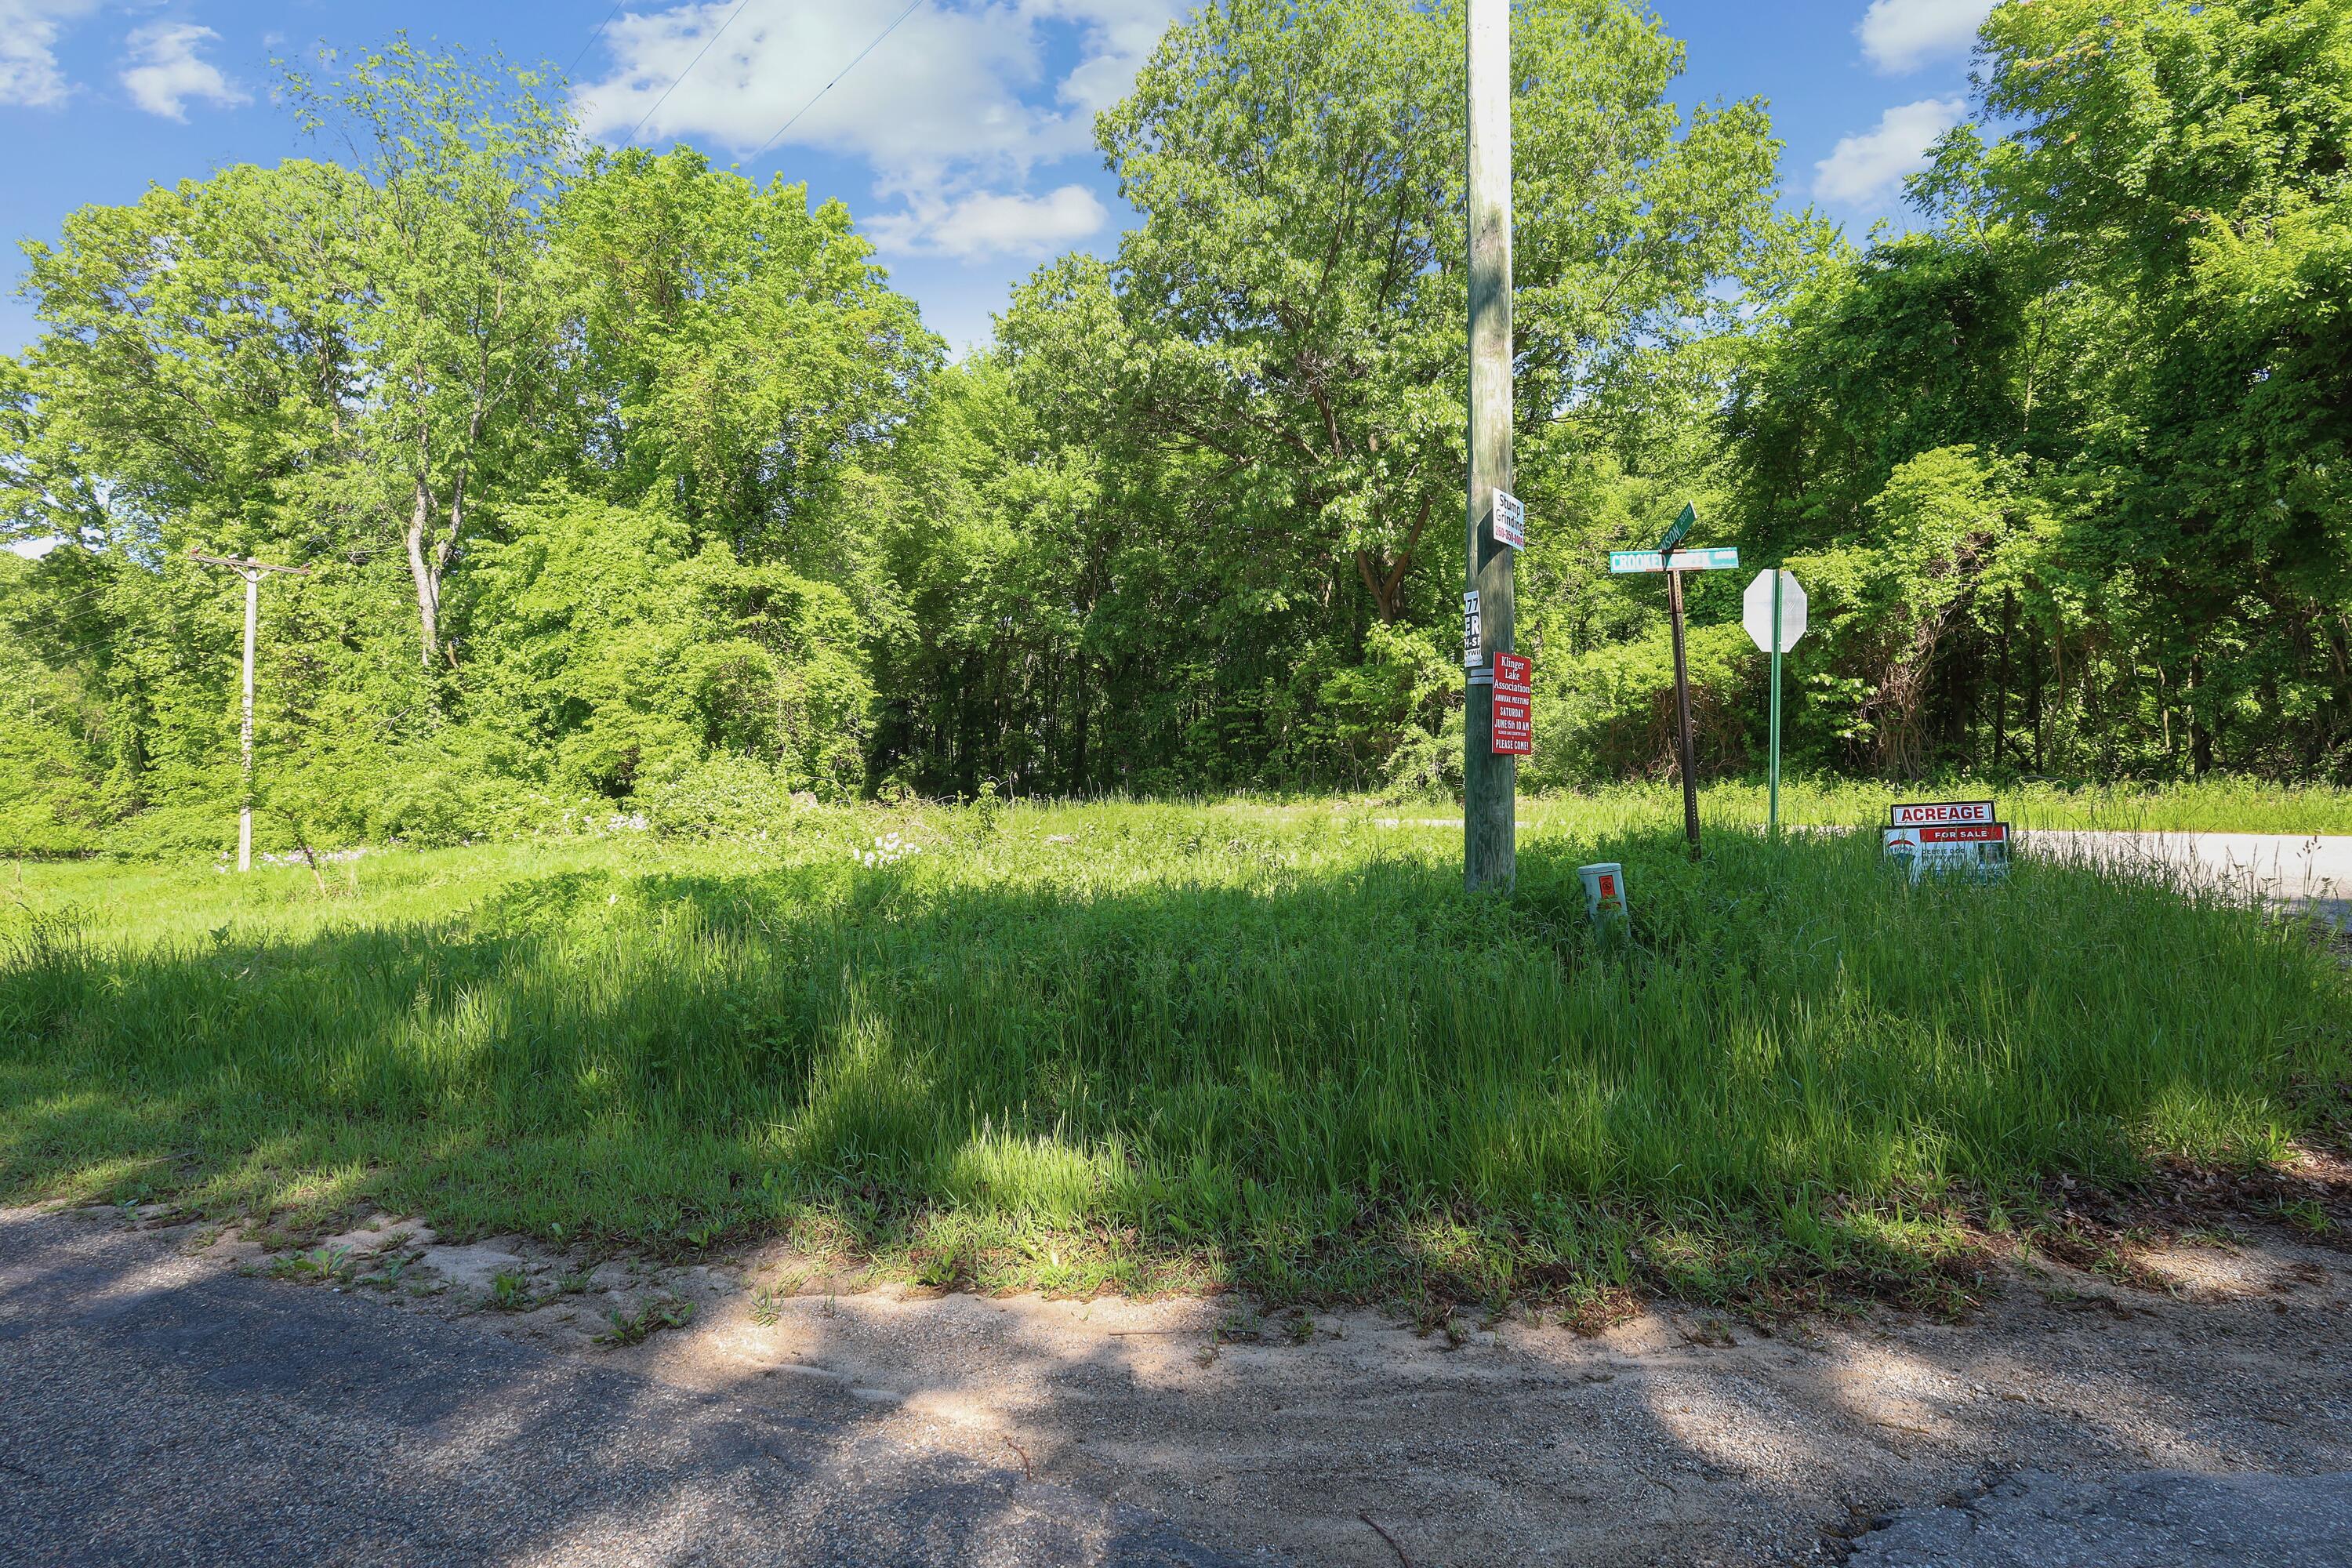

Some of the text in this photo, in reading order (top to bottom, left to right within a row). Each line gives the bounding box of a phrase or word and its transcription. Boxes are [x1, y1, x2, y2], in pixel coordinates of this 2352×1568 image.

[1499, 494, 1521, 518] Stump
[1495, 509, 1523, 536] Grinding
[1611, 554, 1667, 571] CROOKED
[1501, 655, 1525, 672] Klinger
[1504, 668, 1520, 681] Lake
[1494, 679, 1530, 694] Association
[1494, 694, 1530, 706] ANNUAL MEETING
[1500, 706, 1524, 718] SATURDAY
[1494, 718, 1507, 729] JUNE
[1516, 720, 1522, 730] 10
[1522, 721, 1530, 731] AM
[1495, 739, 1530, 751] PLEASE COME!
[1901, 805, 1985, 822] ACREAGE
